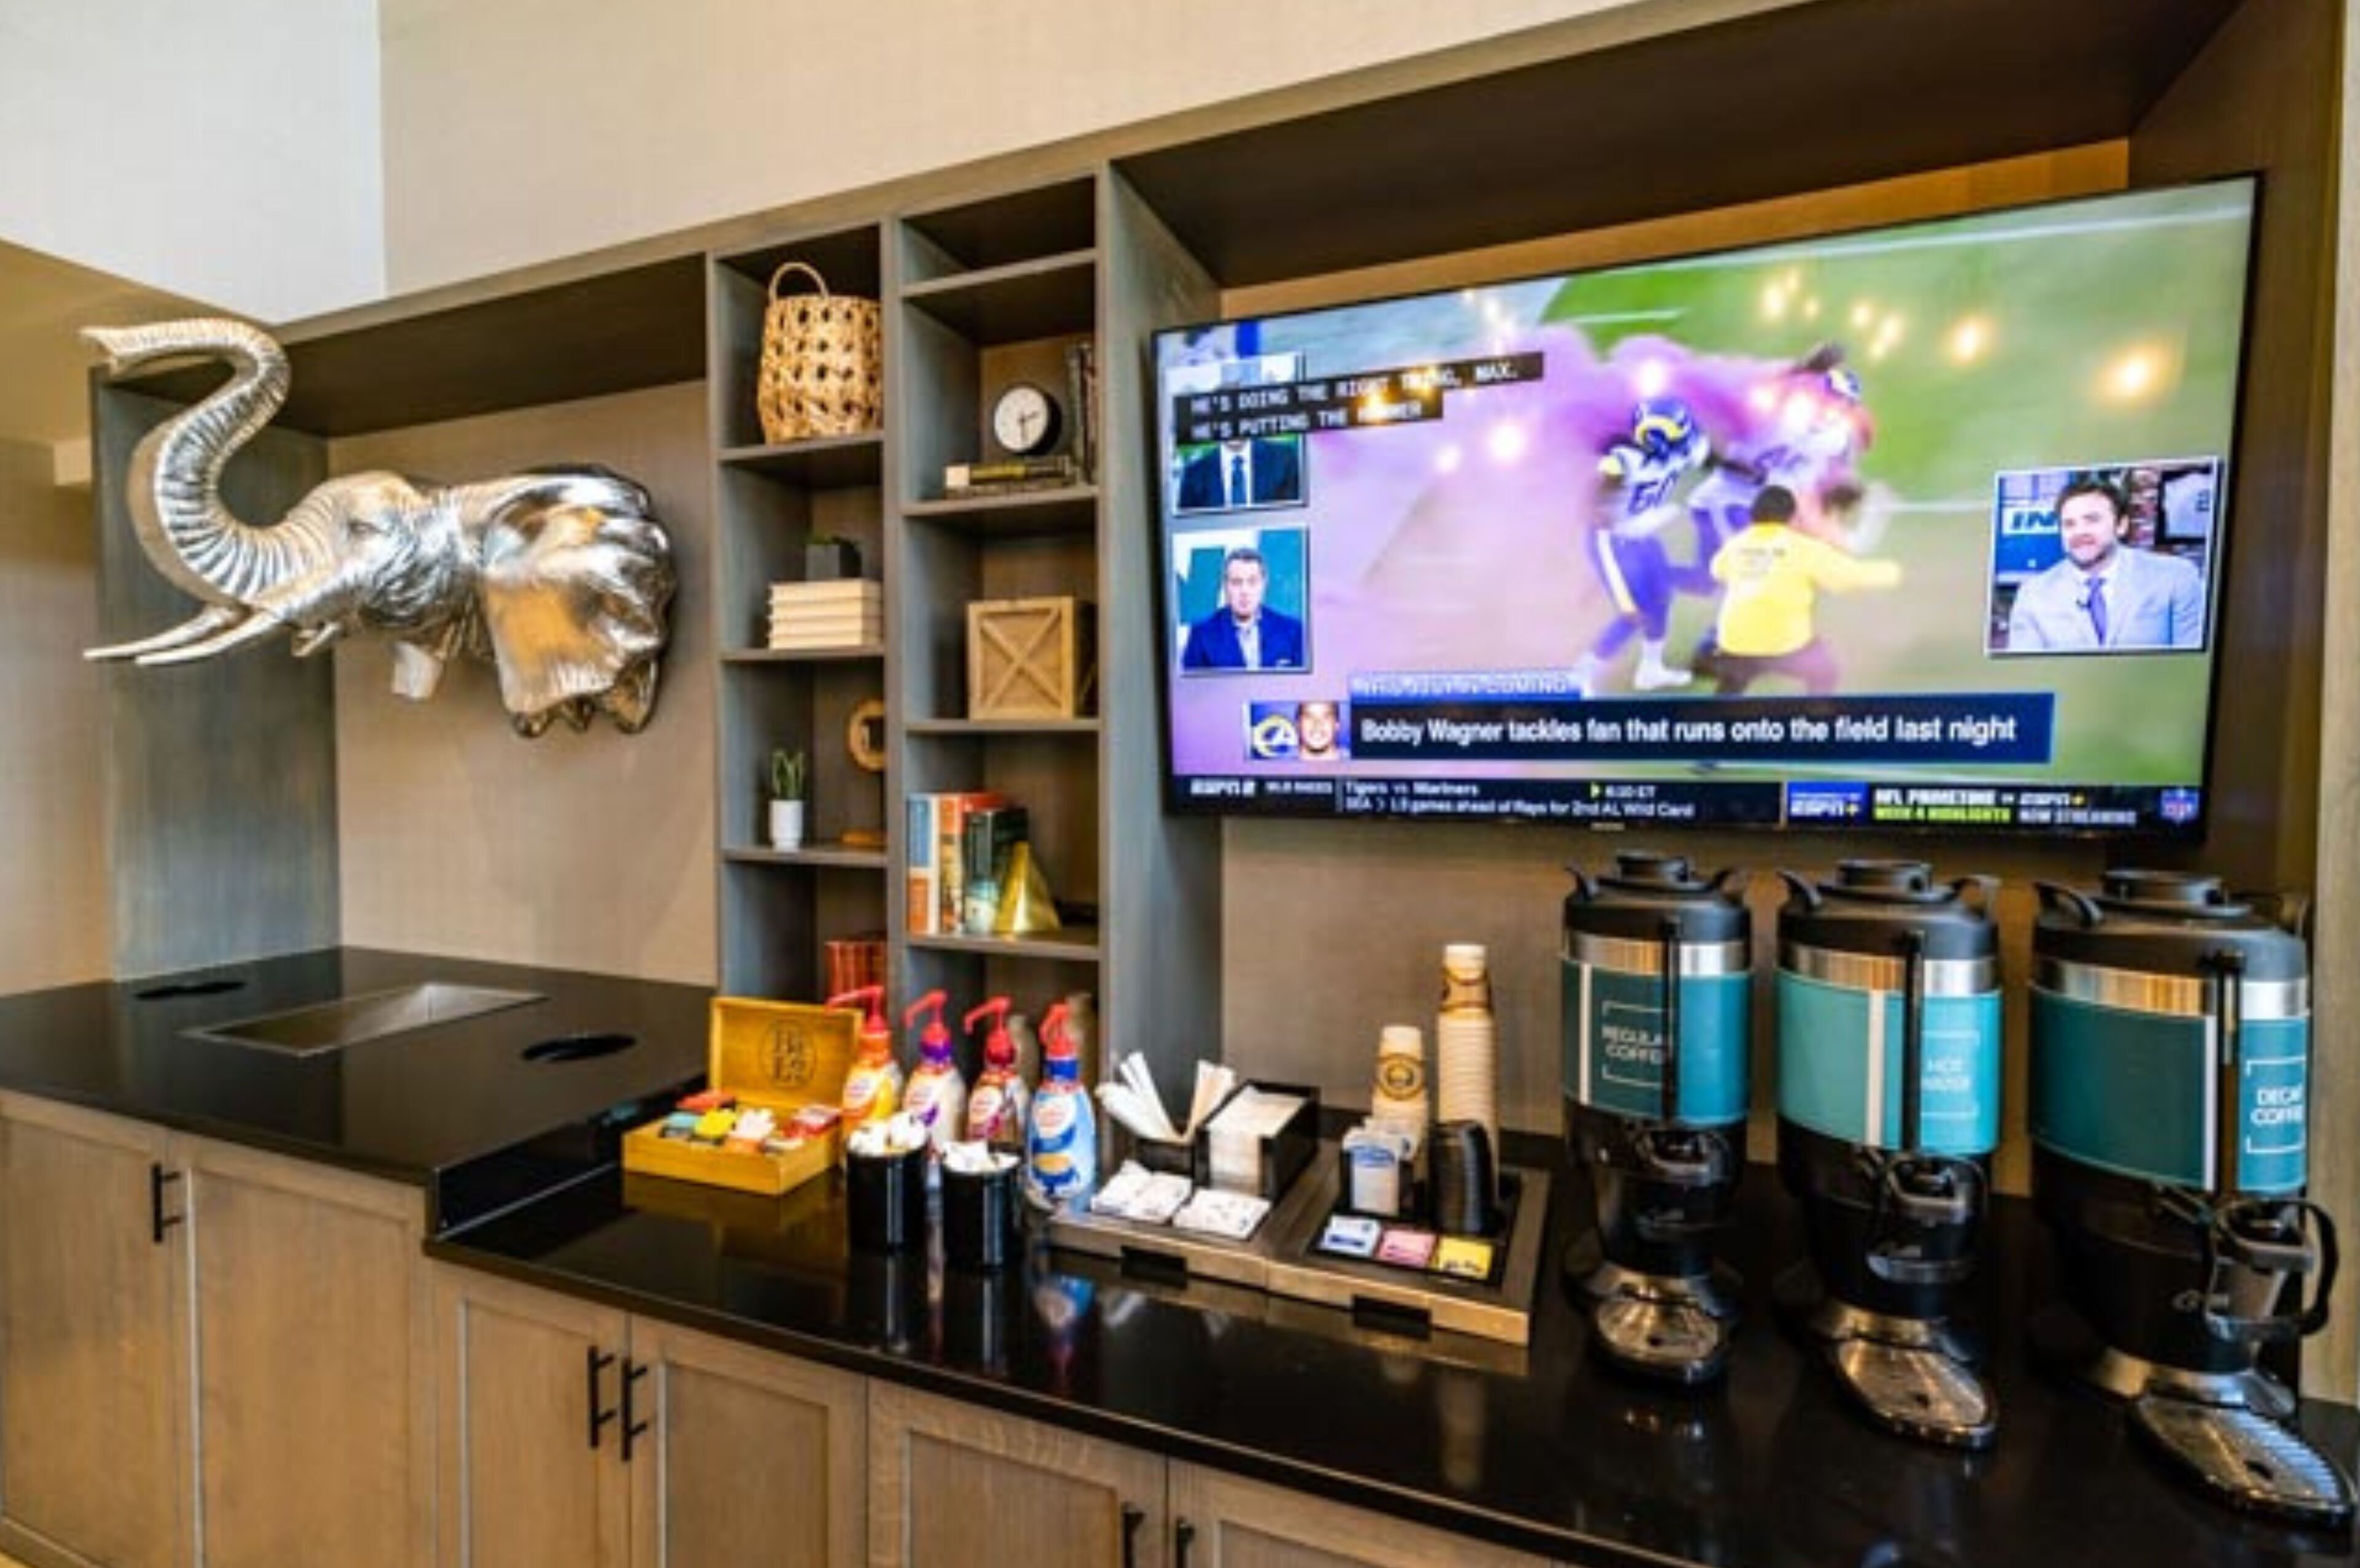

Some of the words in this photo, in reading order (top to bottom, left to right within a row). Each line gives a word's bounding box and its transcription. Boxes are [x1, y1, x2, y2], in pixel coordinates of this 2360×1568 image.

[1238, 387, 1289, 409] DOING
[1297, 382, 1329, 401] THE
[1238, 410, 1310, 434] PUTTING
[1317, 408, 1348, 426] THE
[1361, 717, 1423, 747] Bobby
[1427, 717, 1502, 747] Wagner
[1508, 717, 1581, 742] tackles
[1586, 716, 1621, 742] fan
[1626, 716, 1669, 742] that
[1674, 720, 1725, 742] runs
[1730, 715, 1784, 741] onto
[1790, 715, 1829, 741] the
[1835, 715, 1888, 741] field
[1894, 715, 1941, 741] last
[1949, 714, 2017, 746] night
[1346, 780, 1387, 798] Tigers
[1413, 781, 1479, 796] Mariners
[1412, 799, 1451, 815] games
[1457, 798, 1495, 813] ahead
[1549, 799, 1570, 813] for
[1571, 800, 1599, 816] 2nd
[1600, 802, 1622, 816] AL
[1623, 801, 1655, 817] Wild
[1658, 801, 1694, 818] Card
